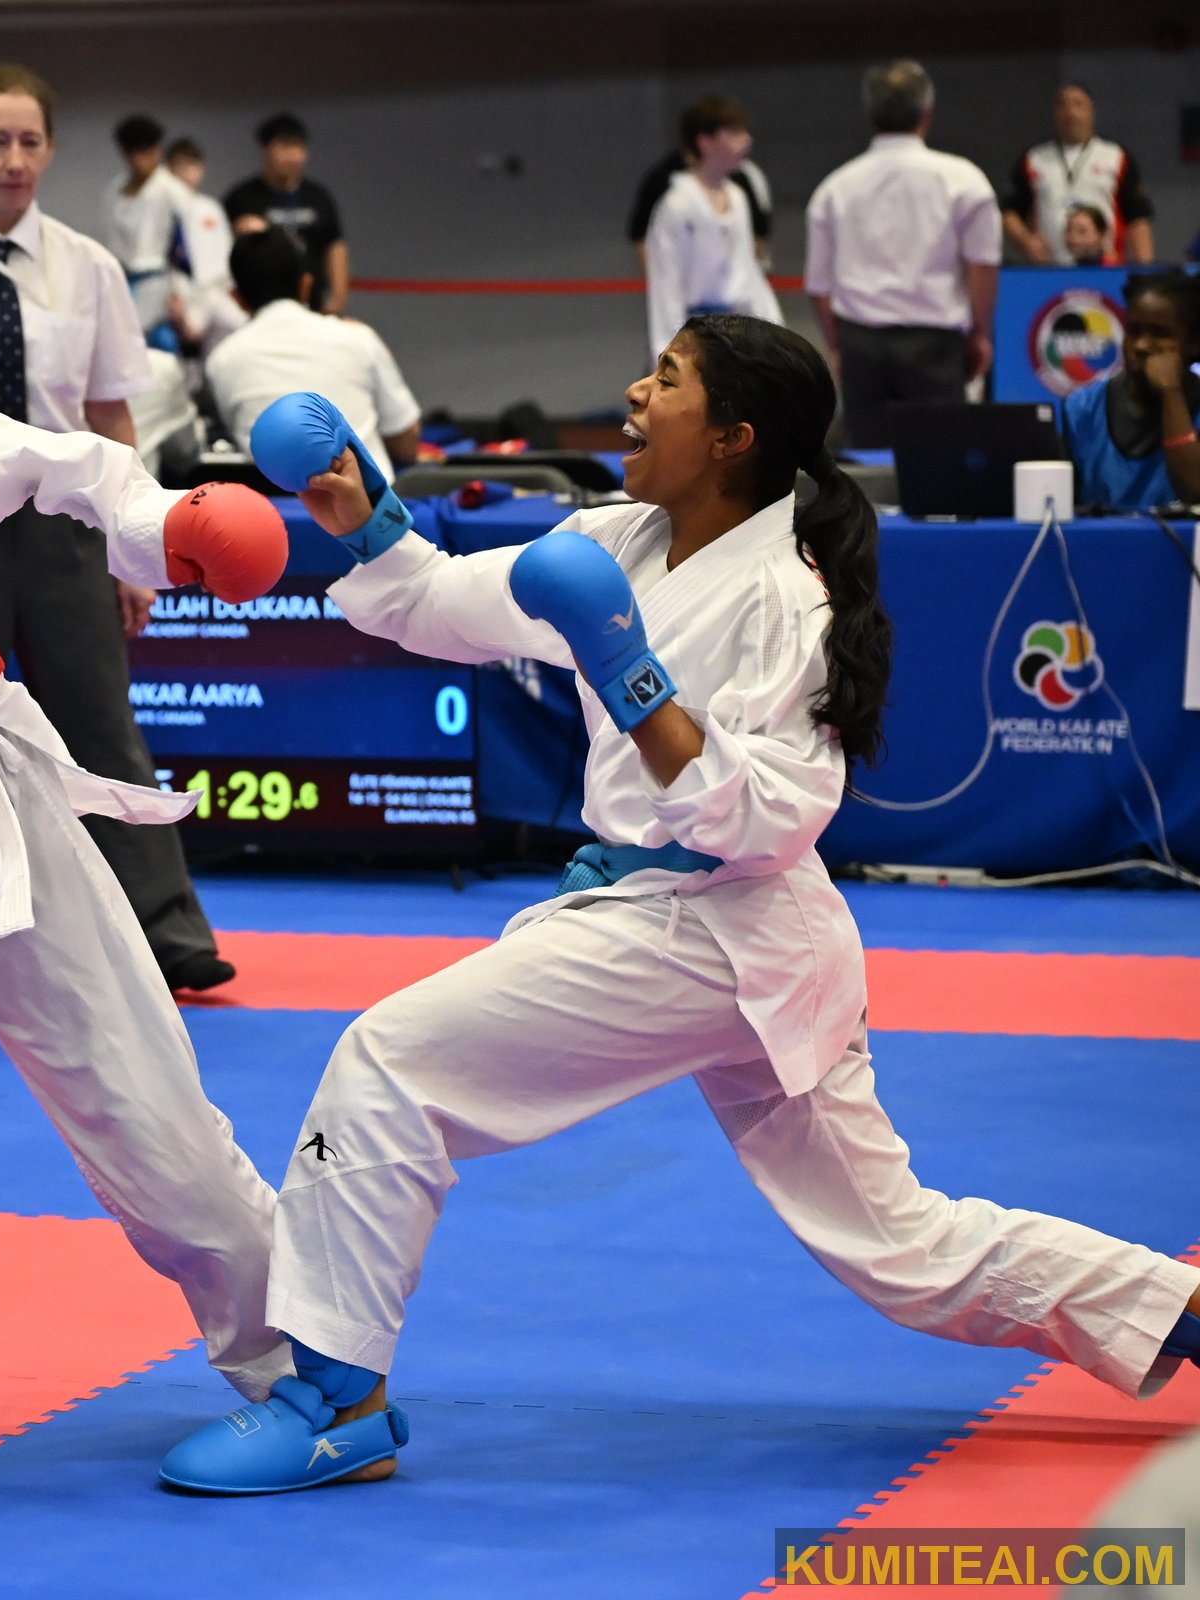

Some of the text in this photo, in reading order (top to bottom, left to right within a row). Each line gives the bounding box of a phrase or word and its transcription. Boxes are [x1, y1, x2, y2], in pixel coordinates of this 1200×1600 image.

[149, 596, 209, 619] LLAH
[190, 683, 264, 708] AARYA
[435, 685, 468, 736] 0
